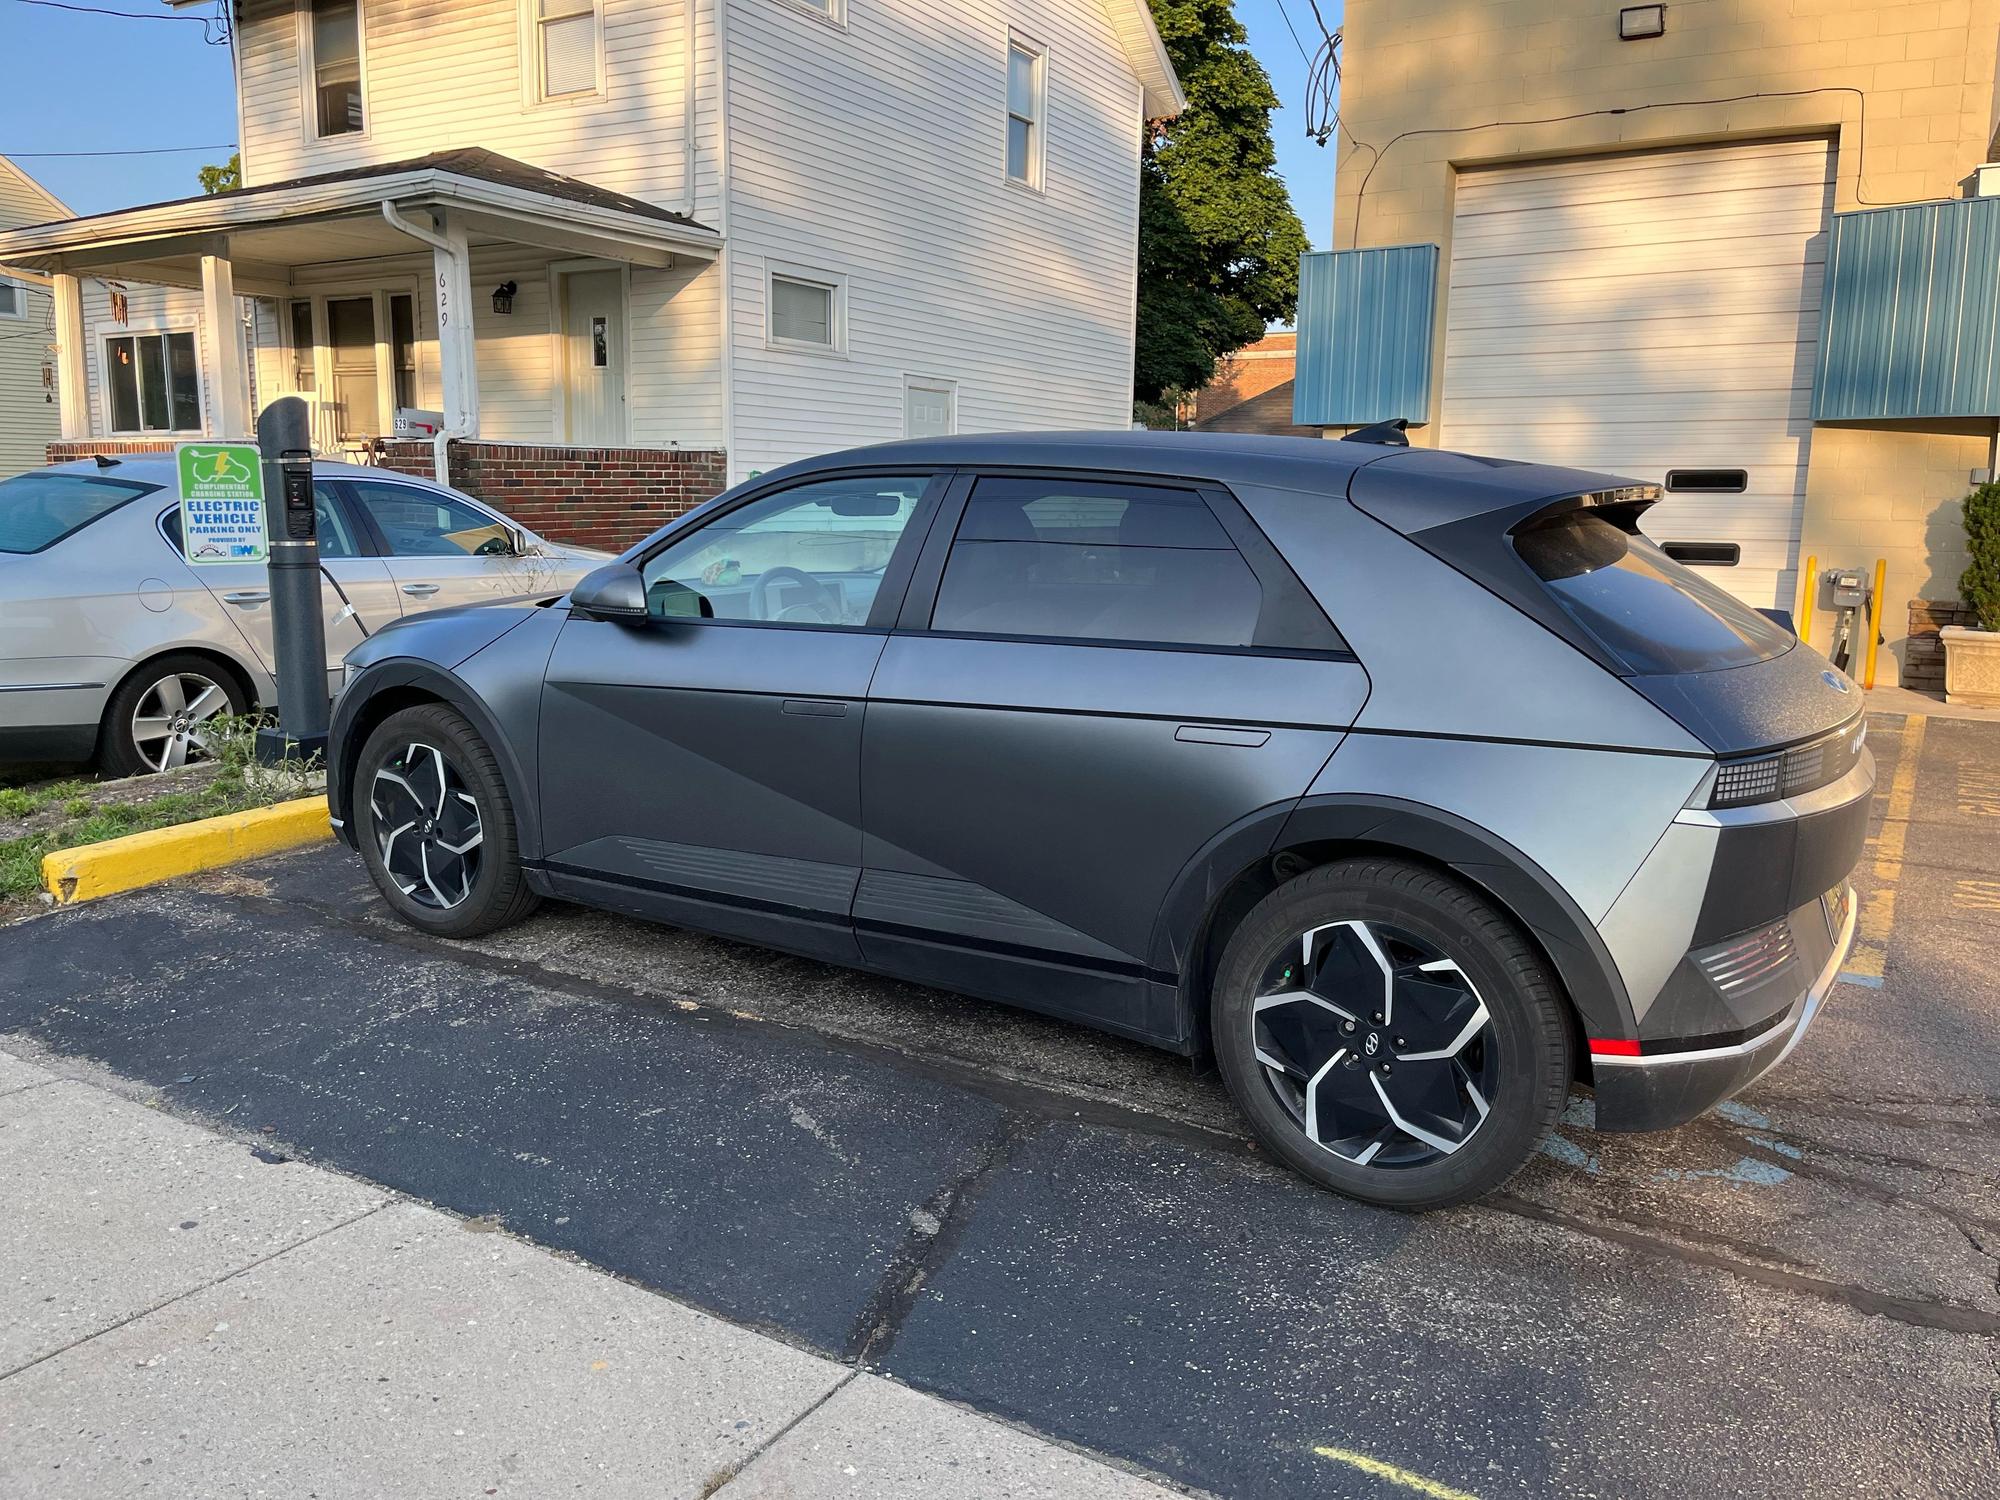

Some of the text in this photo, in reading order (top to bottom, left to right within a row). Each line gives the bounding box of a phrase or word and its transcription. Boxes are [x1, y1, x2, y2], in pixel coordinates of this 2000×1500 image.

[439, 272, 448, 327] 629
[394, 418, 407, 430] 629
[194, 483, 249, 491] COMPLIMENTARY
[191, 490, 254, 498] CHARGING STATION
[187, 500, 260, 512] ELECTRIC
[192, 513, 256, 524] VEHICLE
[189, 526, 235, 534] PARKING
